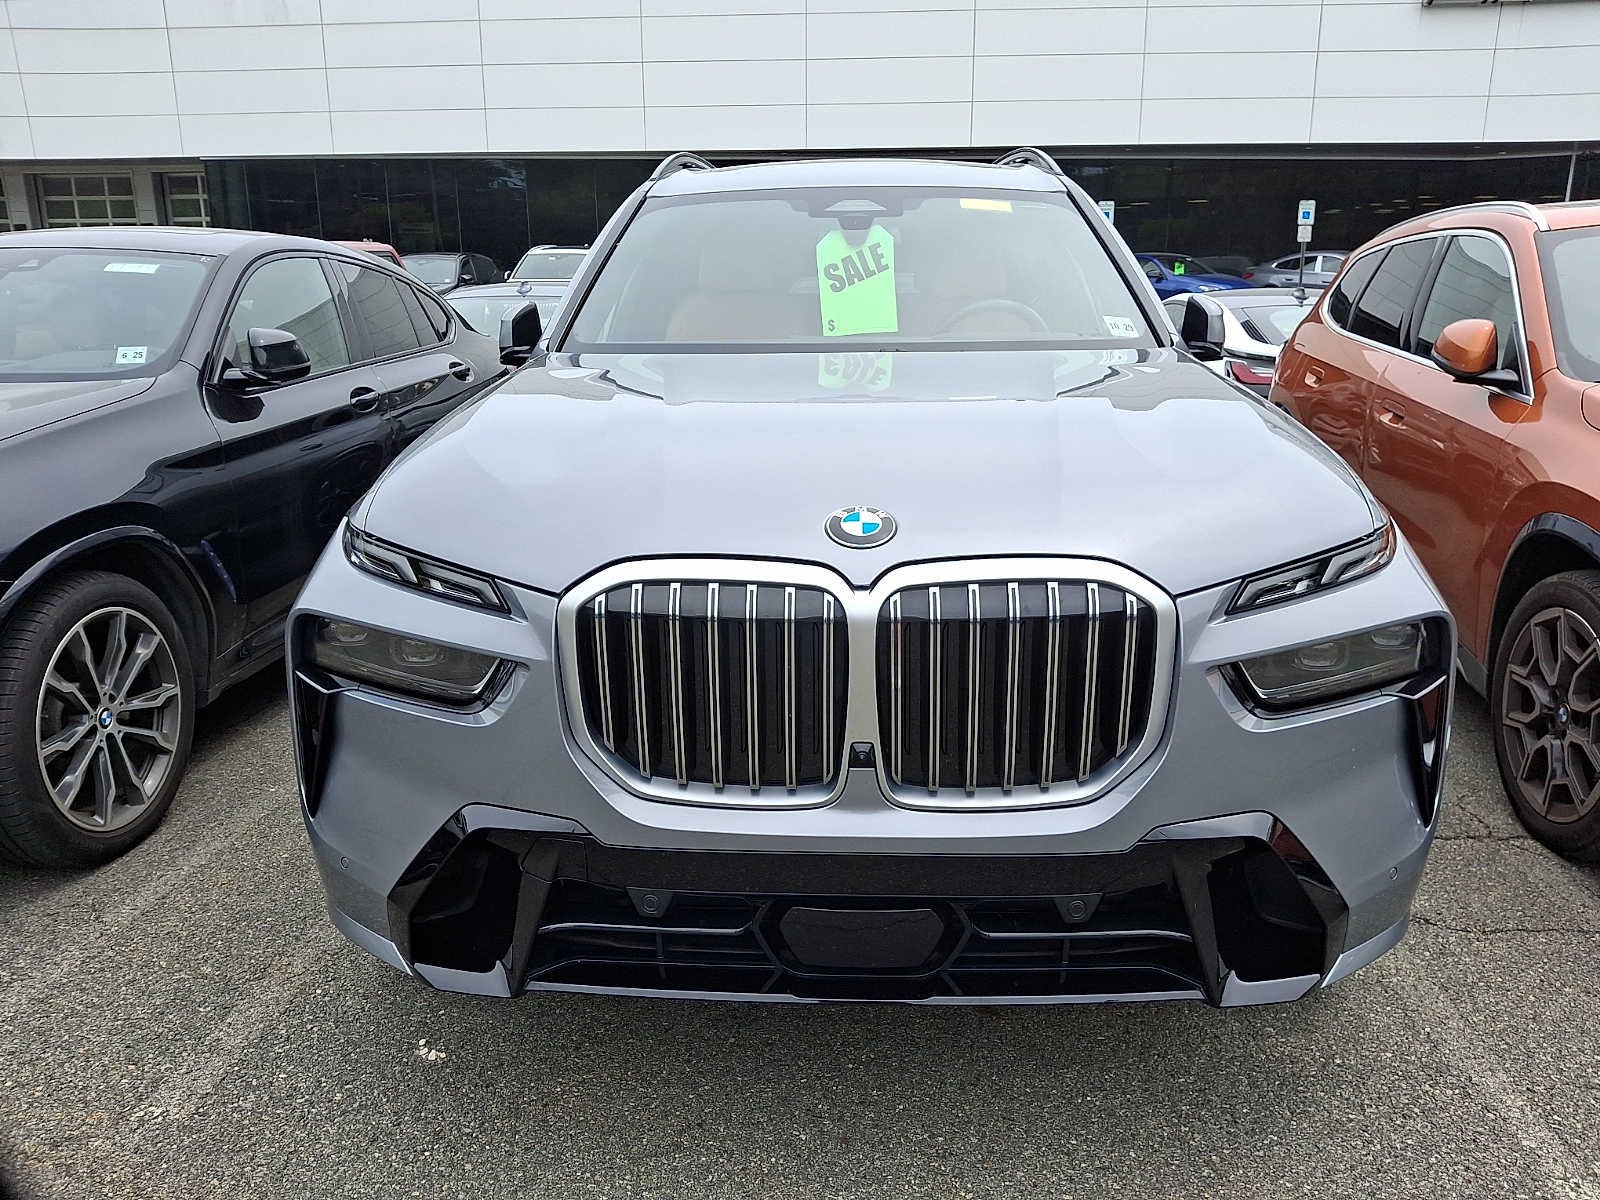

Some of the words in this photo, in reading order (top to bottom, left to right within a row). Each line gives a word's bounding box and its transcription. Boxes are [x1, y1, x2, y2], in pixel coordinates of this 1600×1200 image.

[823, 242, 890, 293] SALE
[827, 319, 836, 332] $
[132, 351, 144, 359] 25
